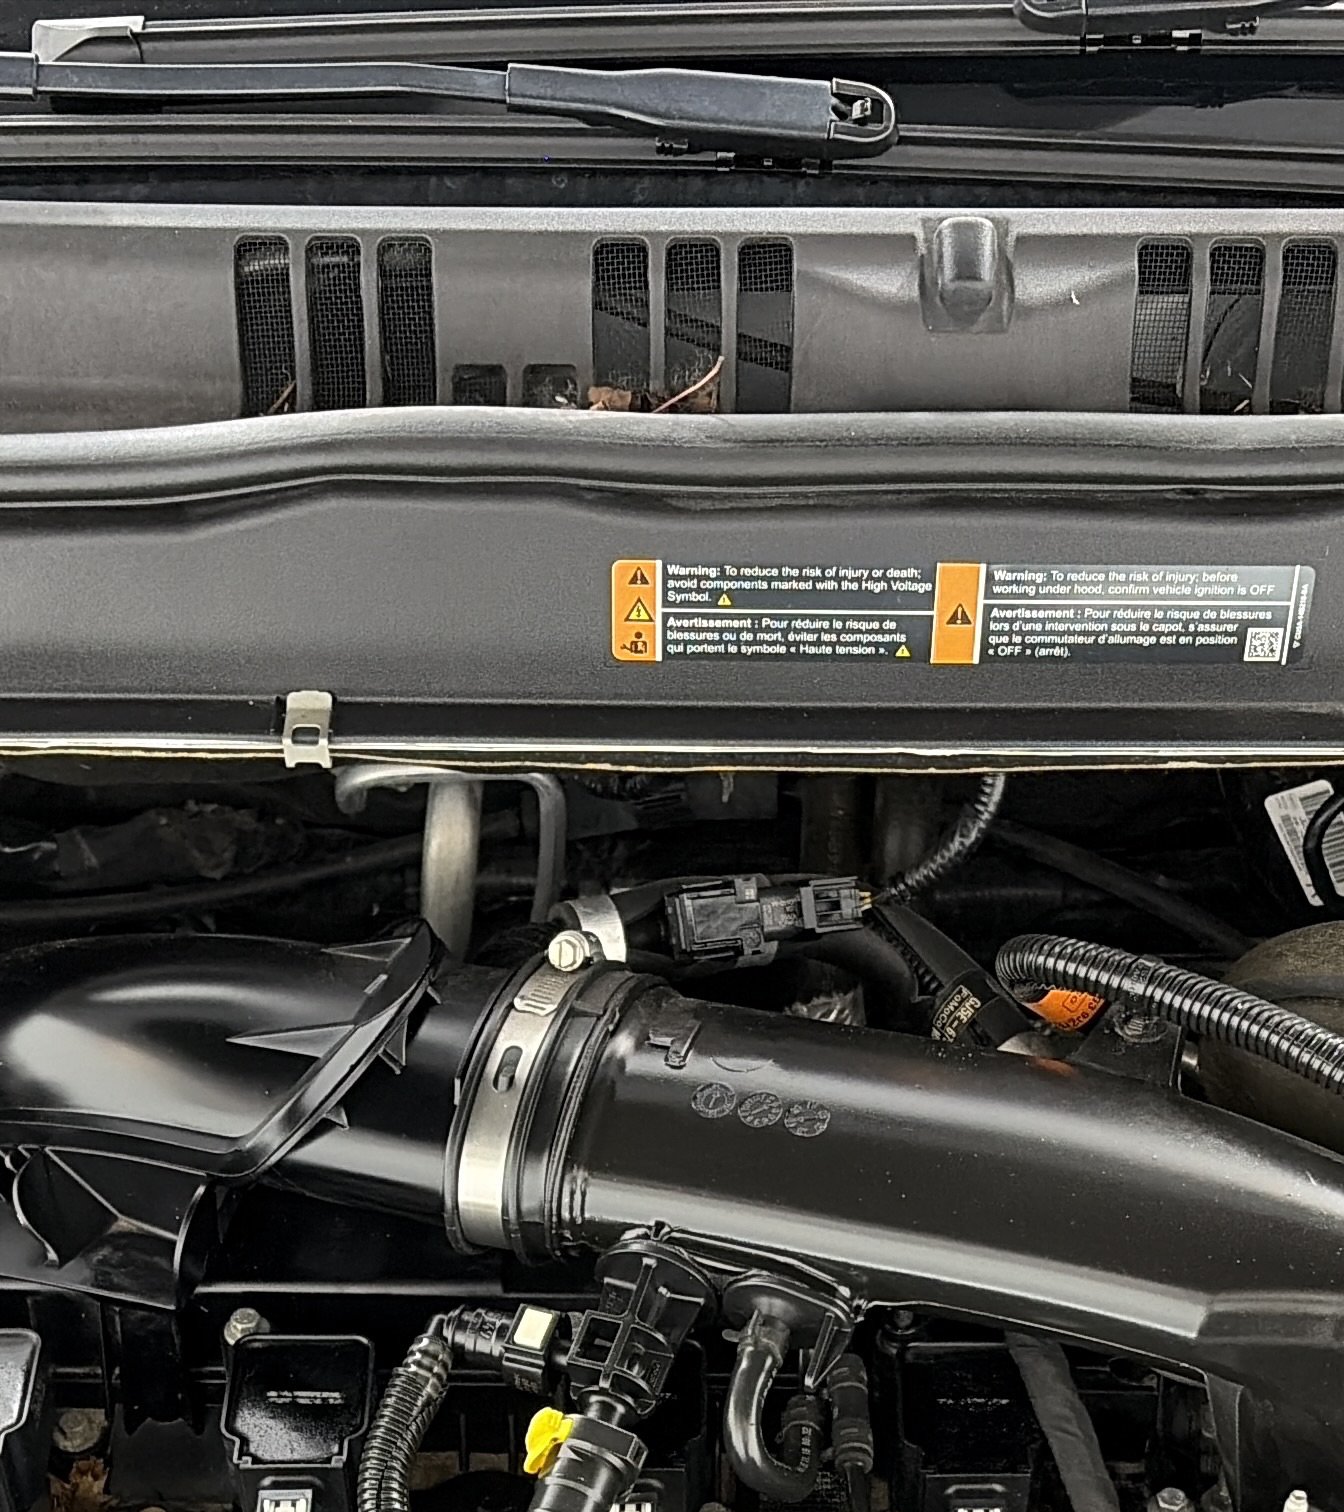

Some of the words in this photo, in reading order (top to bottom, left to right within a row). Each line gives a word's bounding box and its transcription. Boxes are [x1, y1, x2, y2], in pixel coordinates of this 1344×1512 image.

[666, 565, 720, 579] Warning:
[739, 566, 778, 577] reduce
[801, 566, 822, 577] risk
[838, 566, 869, 580] injury
[885, 567, 921, 580] death;
[993, 570, 1046, 584] Warning:
[1066, 570, 1105, 582] reduce
[1128, 570, 1148, 582] risk
[1165, 570, 1200, 584] injury;
[1201, 570, 1238, 582] before
[666, 578, 697, 590] avoid
[699, 579, 768, 592] components
[770, 579, 812, 590] marked
[815, 579, 838, 591] with
[861, 579, 887, 593] High
[890, 580, 932, 594] Voltage
[992, 583, 1036, 597] working
[1038, 583, 1071, 595] under
[1073, 583, 1104, 596] hood,
[1107, 583, 1149, 595] confirm
[1152, 583, 1191, 595] vehicle
[1193, 583, 1234, 598] ignition
[1236, 583, 1248, 595] is
[1249, 583, 1276, 595] OFF
[667, 591, 711, 604] Symbol.
[990, 607, 1074, 619] Avertissement
[1083, 608, 1111, 619] Pour
[1112, 608, 1151, 619] réduire
[1153, 608, 1164, 619] le
[1166, 608, 1200, 622] risque
[1202, 608, 1217, 619] de
[1219, 608, 1272, 619] blessures
[666, 617, 751, 628] Avertissement
[761, 618, 788, 629] Pour
[790, 618, 830, 629] réduire
[832, 618, 842, 629] le
[845, 618, 879, 632] risque
[882, 618, 896, 630] de
[989, 621, 1009, 632] lors
[1011, 621, 1042, 632] d'une
[1044, 621, 1108, 632] intervention
[1110, 623, 1136, 632] sous
[1139, 621, 1149, 632] le
[1151, 621, 1184, 634] capot,
[1188, 621, 1238, 632] s'assurer
[666, 630, 719, 641] blessures
[721, 633, 736, 641] ou
[739, 630, 753, 641] de
[756, 631, 784, 643] mort,
[787, 631, 818, 642] éviter
[820, 631, 837, 642] les
[839, 631, 906, 645] composants
[988, 636, 1009, 647] que
[1011, 634, 1022, 645] le
[1024, 634, 1096, 645] commutateur
[1097, 634, 1156, 647] d'allumage
[1159, 634, 1176, 645] est
[1178, 636, 1192, 645] en
[1194, 634, 1237, 647] position
[666, 642, 683, 656] qui
[686, 643, 724, 656] portent
[727, 643, 737, 653] le
[740, 643, 786, 656] symbole
[799, 643, 832, 654] Haute
[835, 643, 875, 654] tension
[997, 646, 1022, 656] OFF
[1034, 646, 1070, 659] (arrêt).
